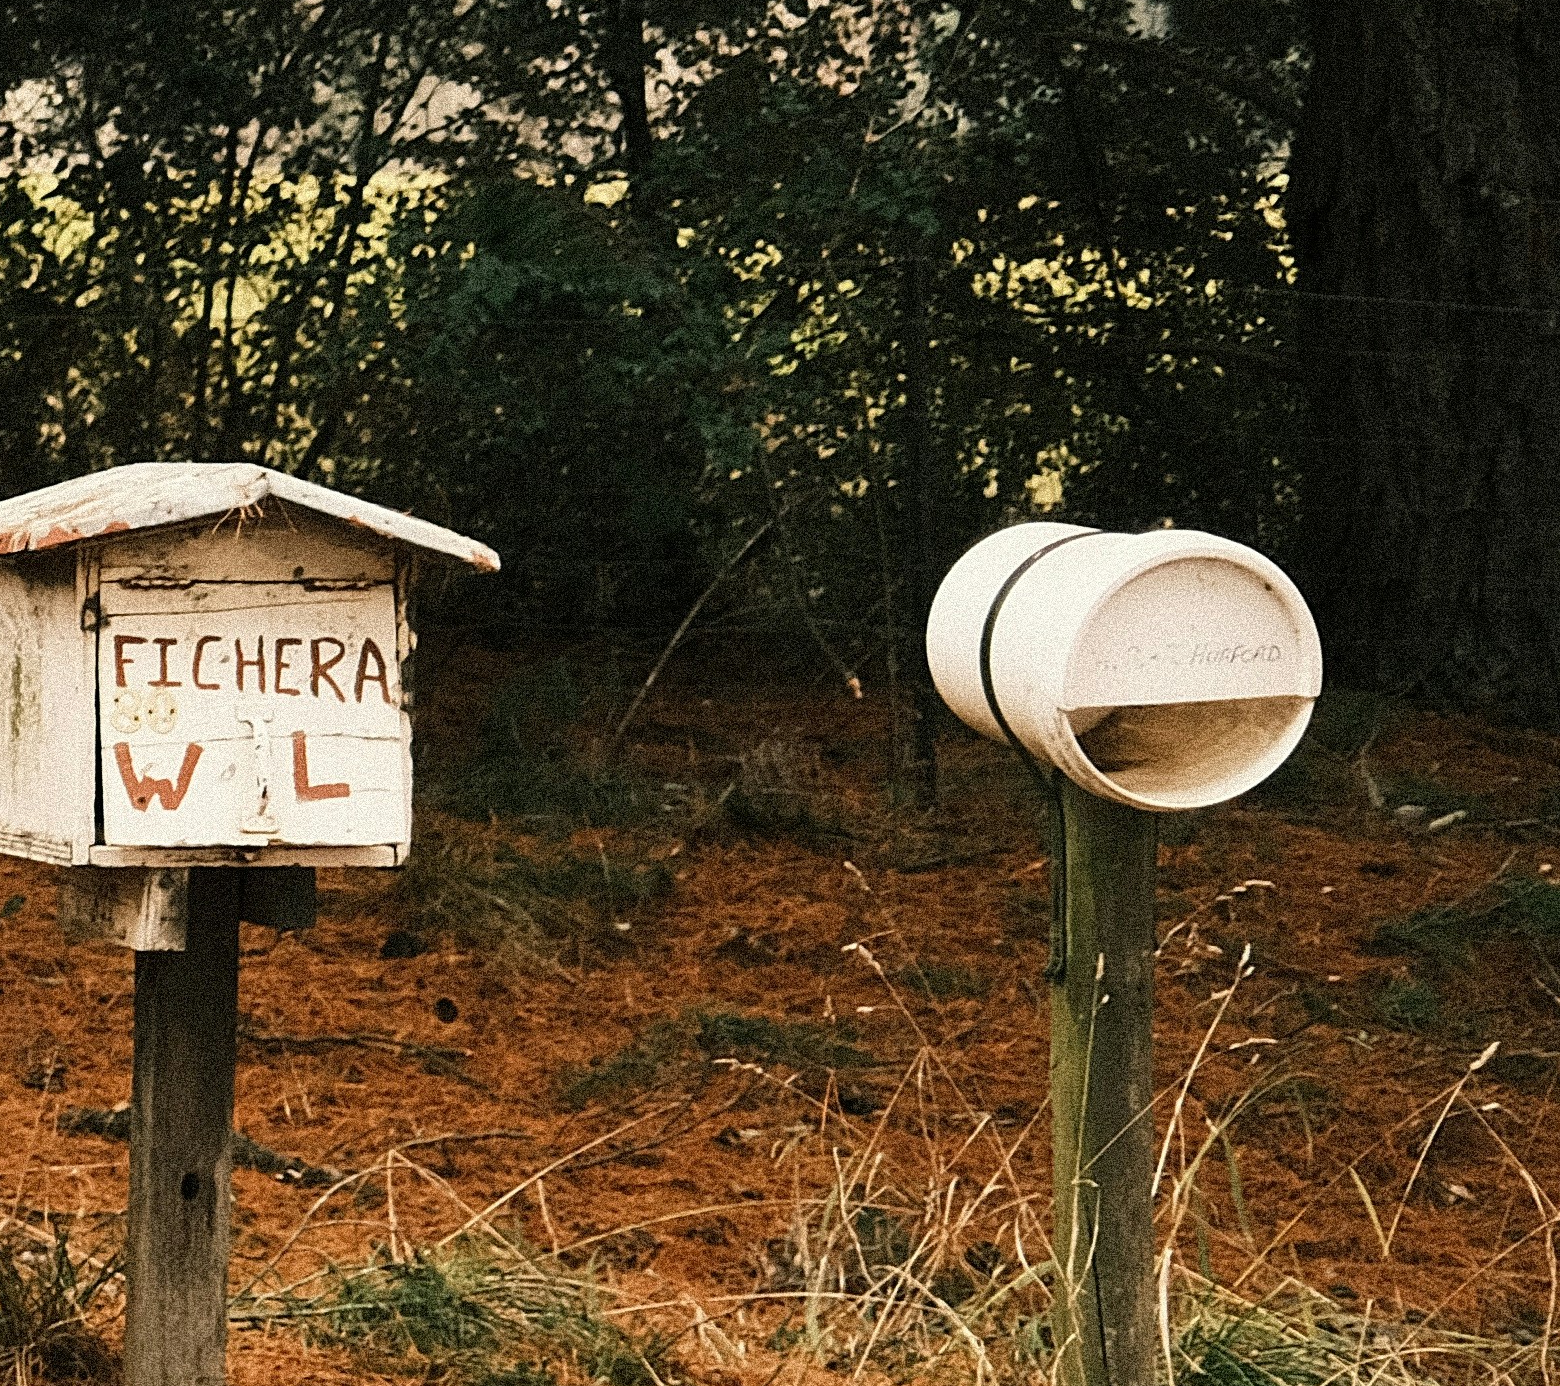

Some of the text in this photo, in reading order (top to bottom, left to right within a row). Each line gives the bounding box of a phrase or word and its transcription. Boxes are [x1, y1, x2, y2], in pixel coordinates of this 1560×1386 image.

[114, 634, 391, 703] FICHERA
[113, 730, 351, 813] W L
